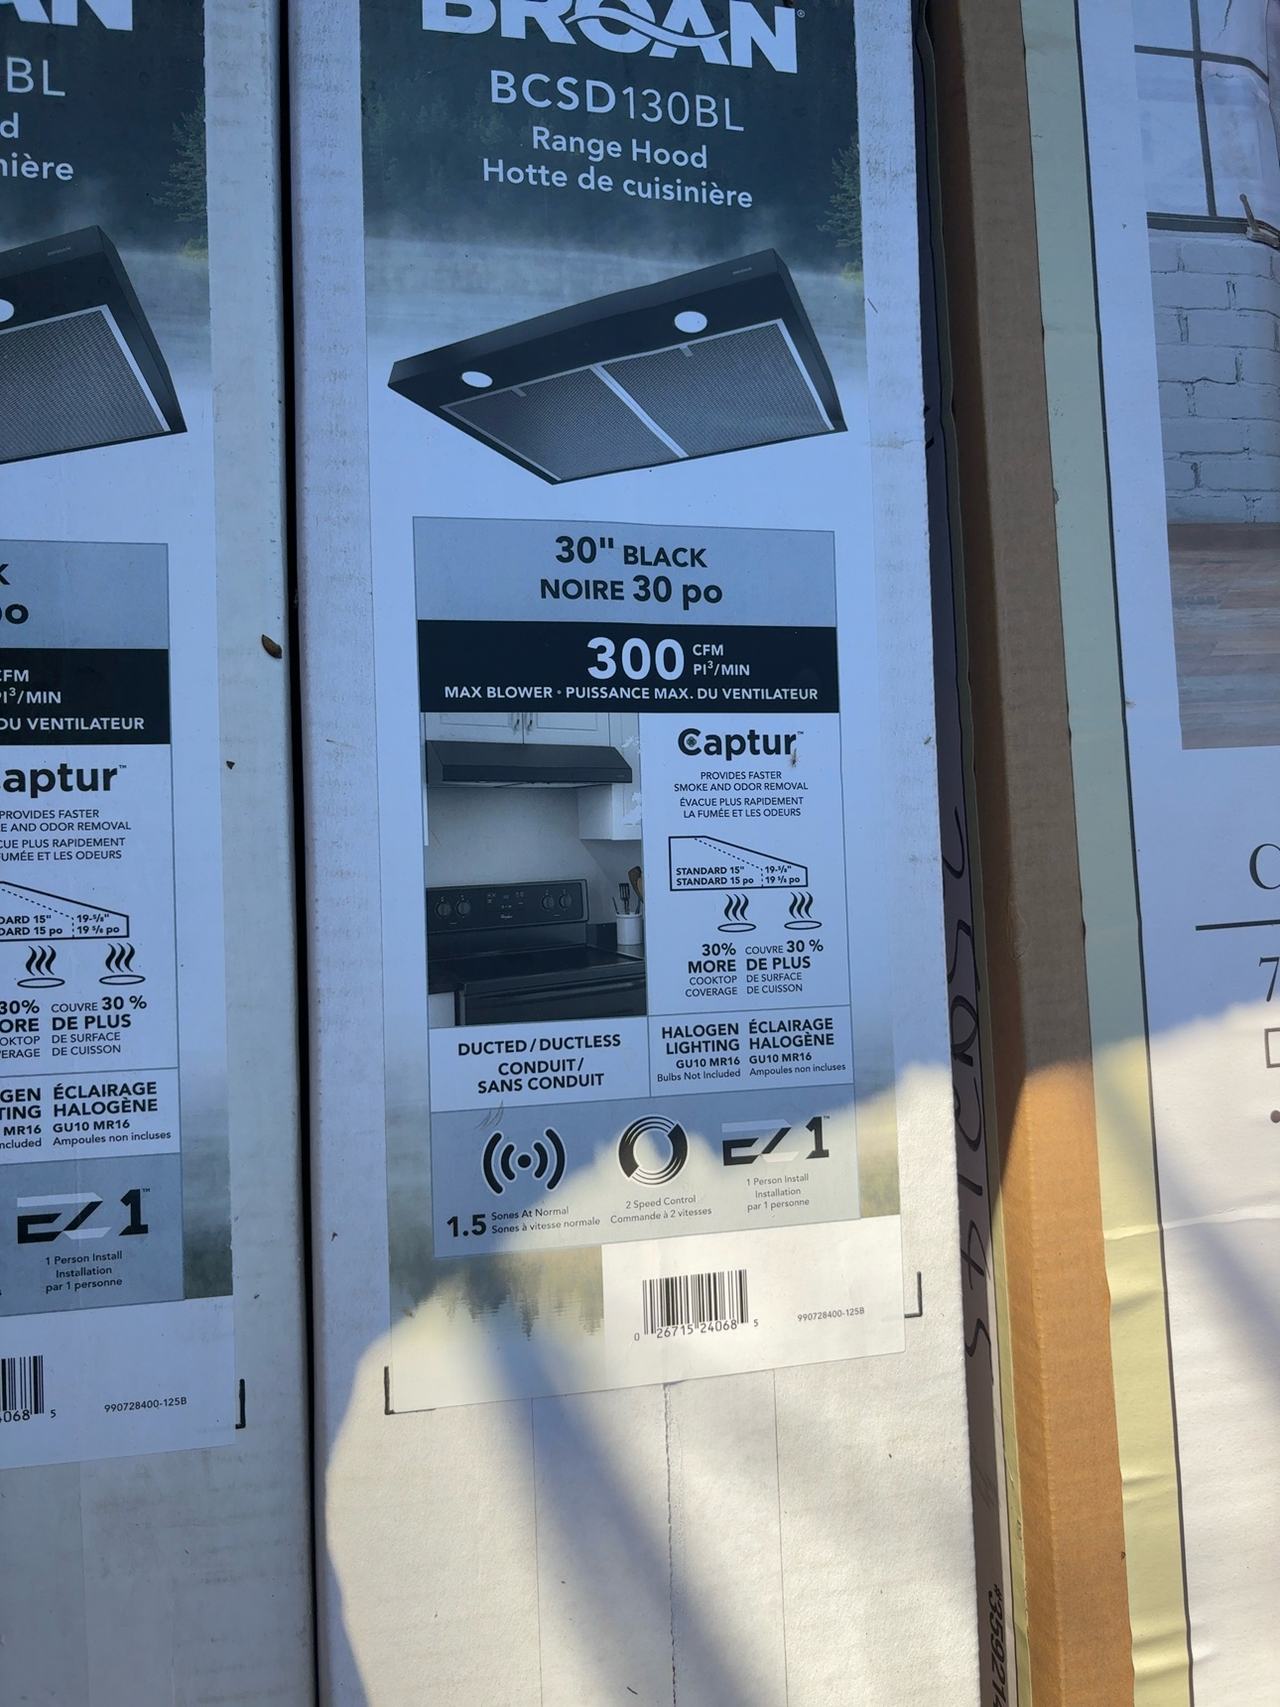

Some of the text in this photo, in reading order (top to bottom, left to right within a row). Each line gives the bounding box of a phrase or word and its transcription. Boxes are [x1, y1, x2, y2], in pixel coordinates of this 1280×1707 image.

[491, 69, 745, 132] BCSD130BL
[532, 126, 708, 170] Range Hood
[482, 158, 753, 209] Hotte de cuisinière
[556, 535, 707, 568] 30" BLACK
[540, 575, 723, 610] NOIRE 30 po
[692, 644, 724, 657] CFM
[587, 636, 685, 681] 300
[445, 686, 818, 700] MAX BLOWER PUISSANCE MAX. DU VENTILATEUR
[27, 717, 145, 730] VENTILATEUR
[700, 771, 782, 780] PROVIDES FASTER
[674, 782, 808, 792] SMOKE AND ODOR REMOVAL
[680, 796, 803, 807] ÉVACUE PLUS RAPIDEMENT
[0, 809, 100, 819] PROVIDES FASTER
[683, 808, 801, 818] LA FUMÉE ET LES ODEURS
[10, 821, 131, 832] AND ODOR REMOVAL
[21, 837, 126, 848] PLUS RAPIDEMENT
[37, 850, 122, 861] ET LES ODEURS
[676, 867, 728, 876] STANDARD
[676, 876, 754, 886] STANDARD 15 po
[765, 876, 776, 884] 19
[789, 875, 801, 885] po
[702, 942, 737, 957] 30%
[745, 945, 784, 955] COUVRE
[786, 940, 805, 953] 30
[688, 959, 736, 974] MORE
[746, 955, 811, 971] DE PLUS
[689, 975, 738, 986] COOKTOP
[746, 972, 802, 983] DE SURFACE
[685, 986, 738, 998] COVERAGE
[746, 983, 803, 995] DE CUISSON
[51, 1002, 98, 1013] COUVRE
[102, 996, 124, 1011] 30
[52, 1013, 132, 1031] DE PLUS
[749, 1017, 834, 1035] ÉCLAIRAGE
[51, 1032, 121, 1044] DE SURFACE
[662, 1022, 740, 1039] HALOGEN
[666, 1038, 740, 1055] LIGHTING
[750, 1032, 835, 1050] HALOGÈNE
[52, 1045, 121, 1057] DE CUISSON
[749, 1052, 812, 1065] GU10 MR16
[676, 1056, 741, 1069] GU10 MR16
[657, 1069, 741, 1083] Bulbs Not Included
[750, 1063, 846, 1078] Ampoules non incluses
[53, 1081, 157, 1100] ÉCLAIRAGE
[478, 1073, 605, 1094] SANS CONDUIT
[54, 1097, 158, 1117] HALOGÈNE
[3, 1125, 42, 1137] MR16
[52, 1119, 130, 1134] GU10 MR16
[52, 1131, 171, 1147] Ampoules non incluses
[753, 1176, 782, 1186] Person
[784, 1173, 809, 1183] Install
[755, 1187, 801, 1198] Installation
[625, 1195, 697, 1211] 2 Speed Control
[747, 1202, 762, 1212] par
[770, 1197, 810, 1212] personne
[491, 1206, 569, 1221] Sones At Normal
[610, 1206, 712, 1224] Commande à 2 vitesses
[446, 1214, 487, 1238] 1.5
[491, 1217, 601, 1235] Sones à vitesse normale
[54, 1254, 90, 1265] Person
[92, 1251, 123, 1262] Install
[56, 1265, 112, 1279] Installation
[45, 1283, 64, 1294] par
[74, 1277, 123, 1293] personne
[797, 1306, 865, 1322] 990728400-125B
[656, 1324, 694, 1340] 26715
[700, 1320, 738, 1334] 24068
[753, 1319, 759, 1327] 5
[104, 1396, 187, 1413] 990728400-125B
